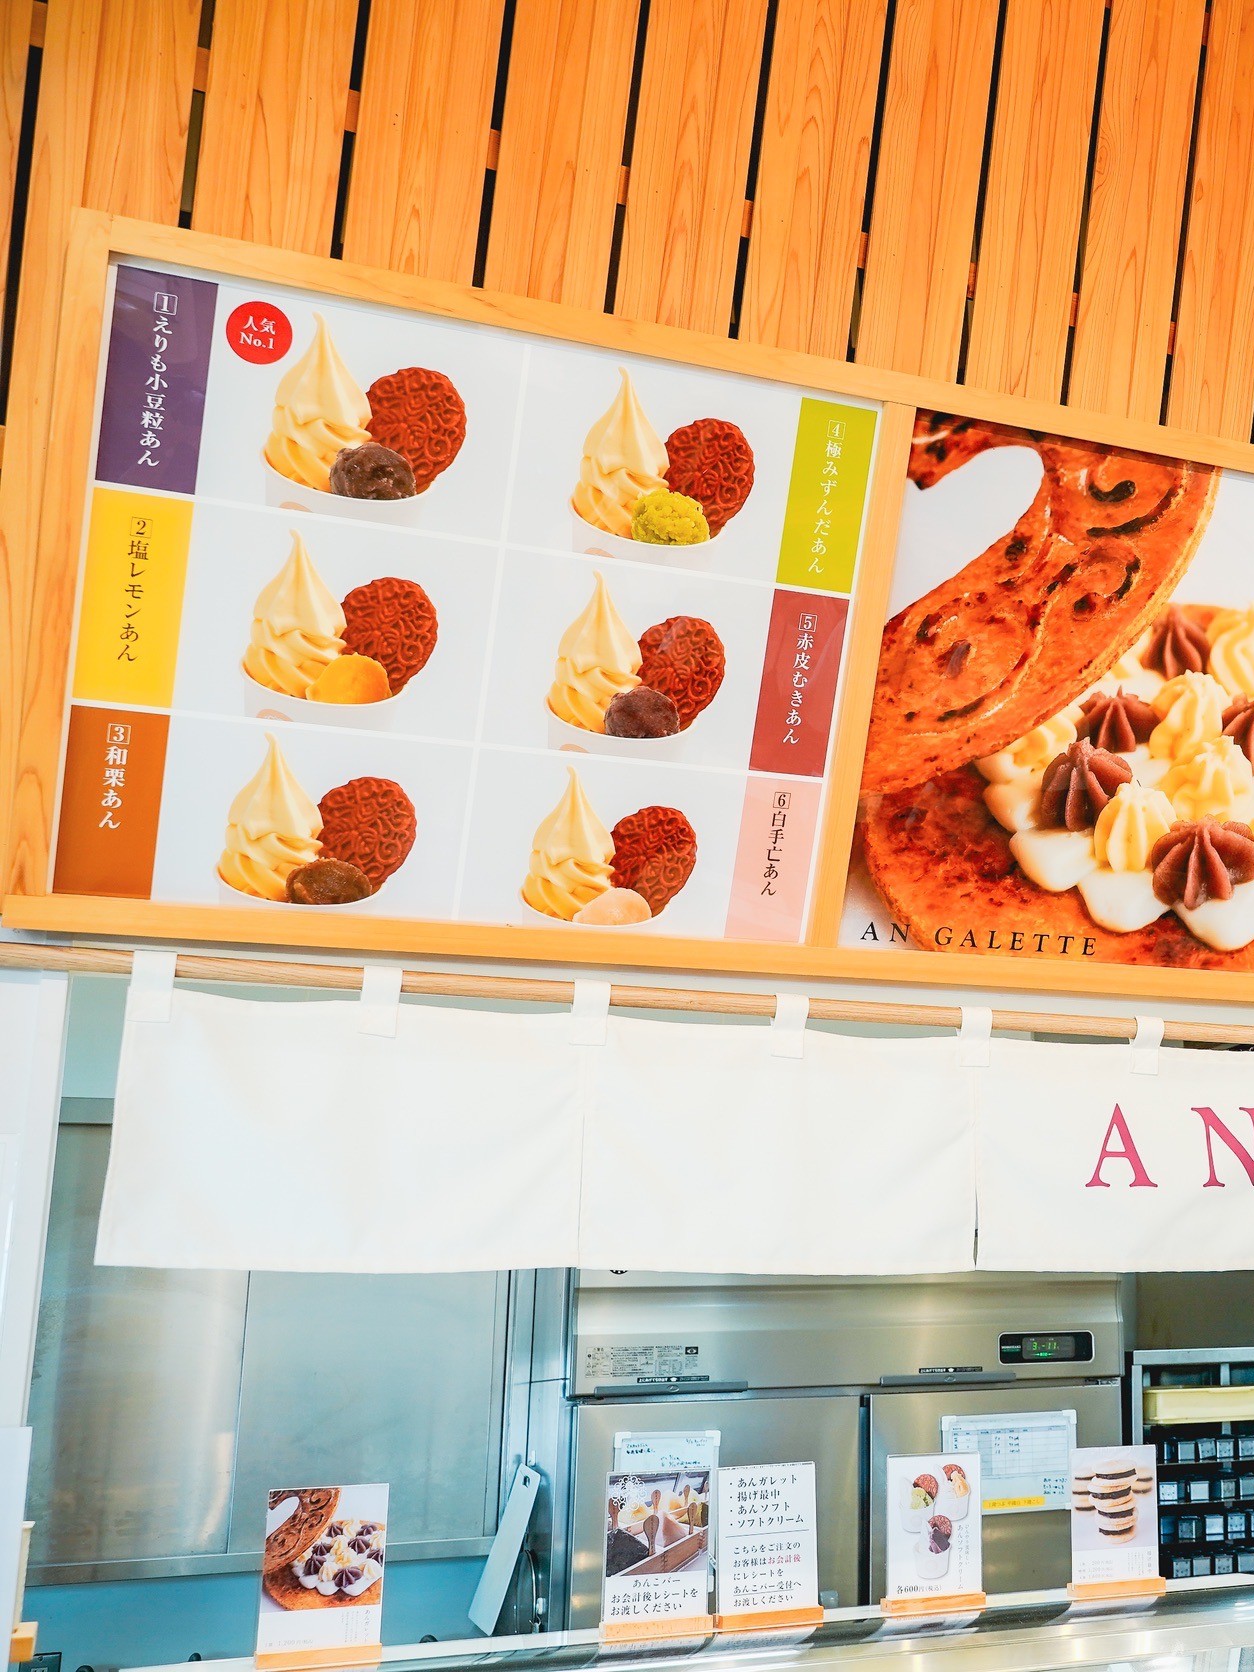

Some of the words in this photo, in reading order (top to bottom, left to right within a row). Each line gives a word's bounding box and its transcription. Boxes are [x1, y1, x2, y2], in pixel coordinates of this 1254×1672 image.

[243, 316, 277, 335] 人気
[239, 331, 275, 350] No.1
[860, 921, 912, 943] AN
[935, 926, 1097, 956] GALETTE
[733, 1541, 801, 1555] こちらをご注文の
[733, 1568, 784, 1581] にレシートを
[633, 1578, 681, 1588] あんこバー
[733, 1580, 802, 1595] あんこバー受付へ
[611, 1588, 699, 1604] お会計後レシートを
[733, 1594, 793, 1607] お渡しください
[610, 1602, 682, 1616] お渡しください
